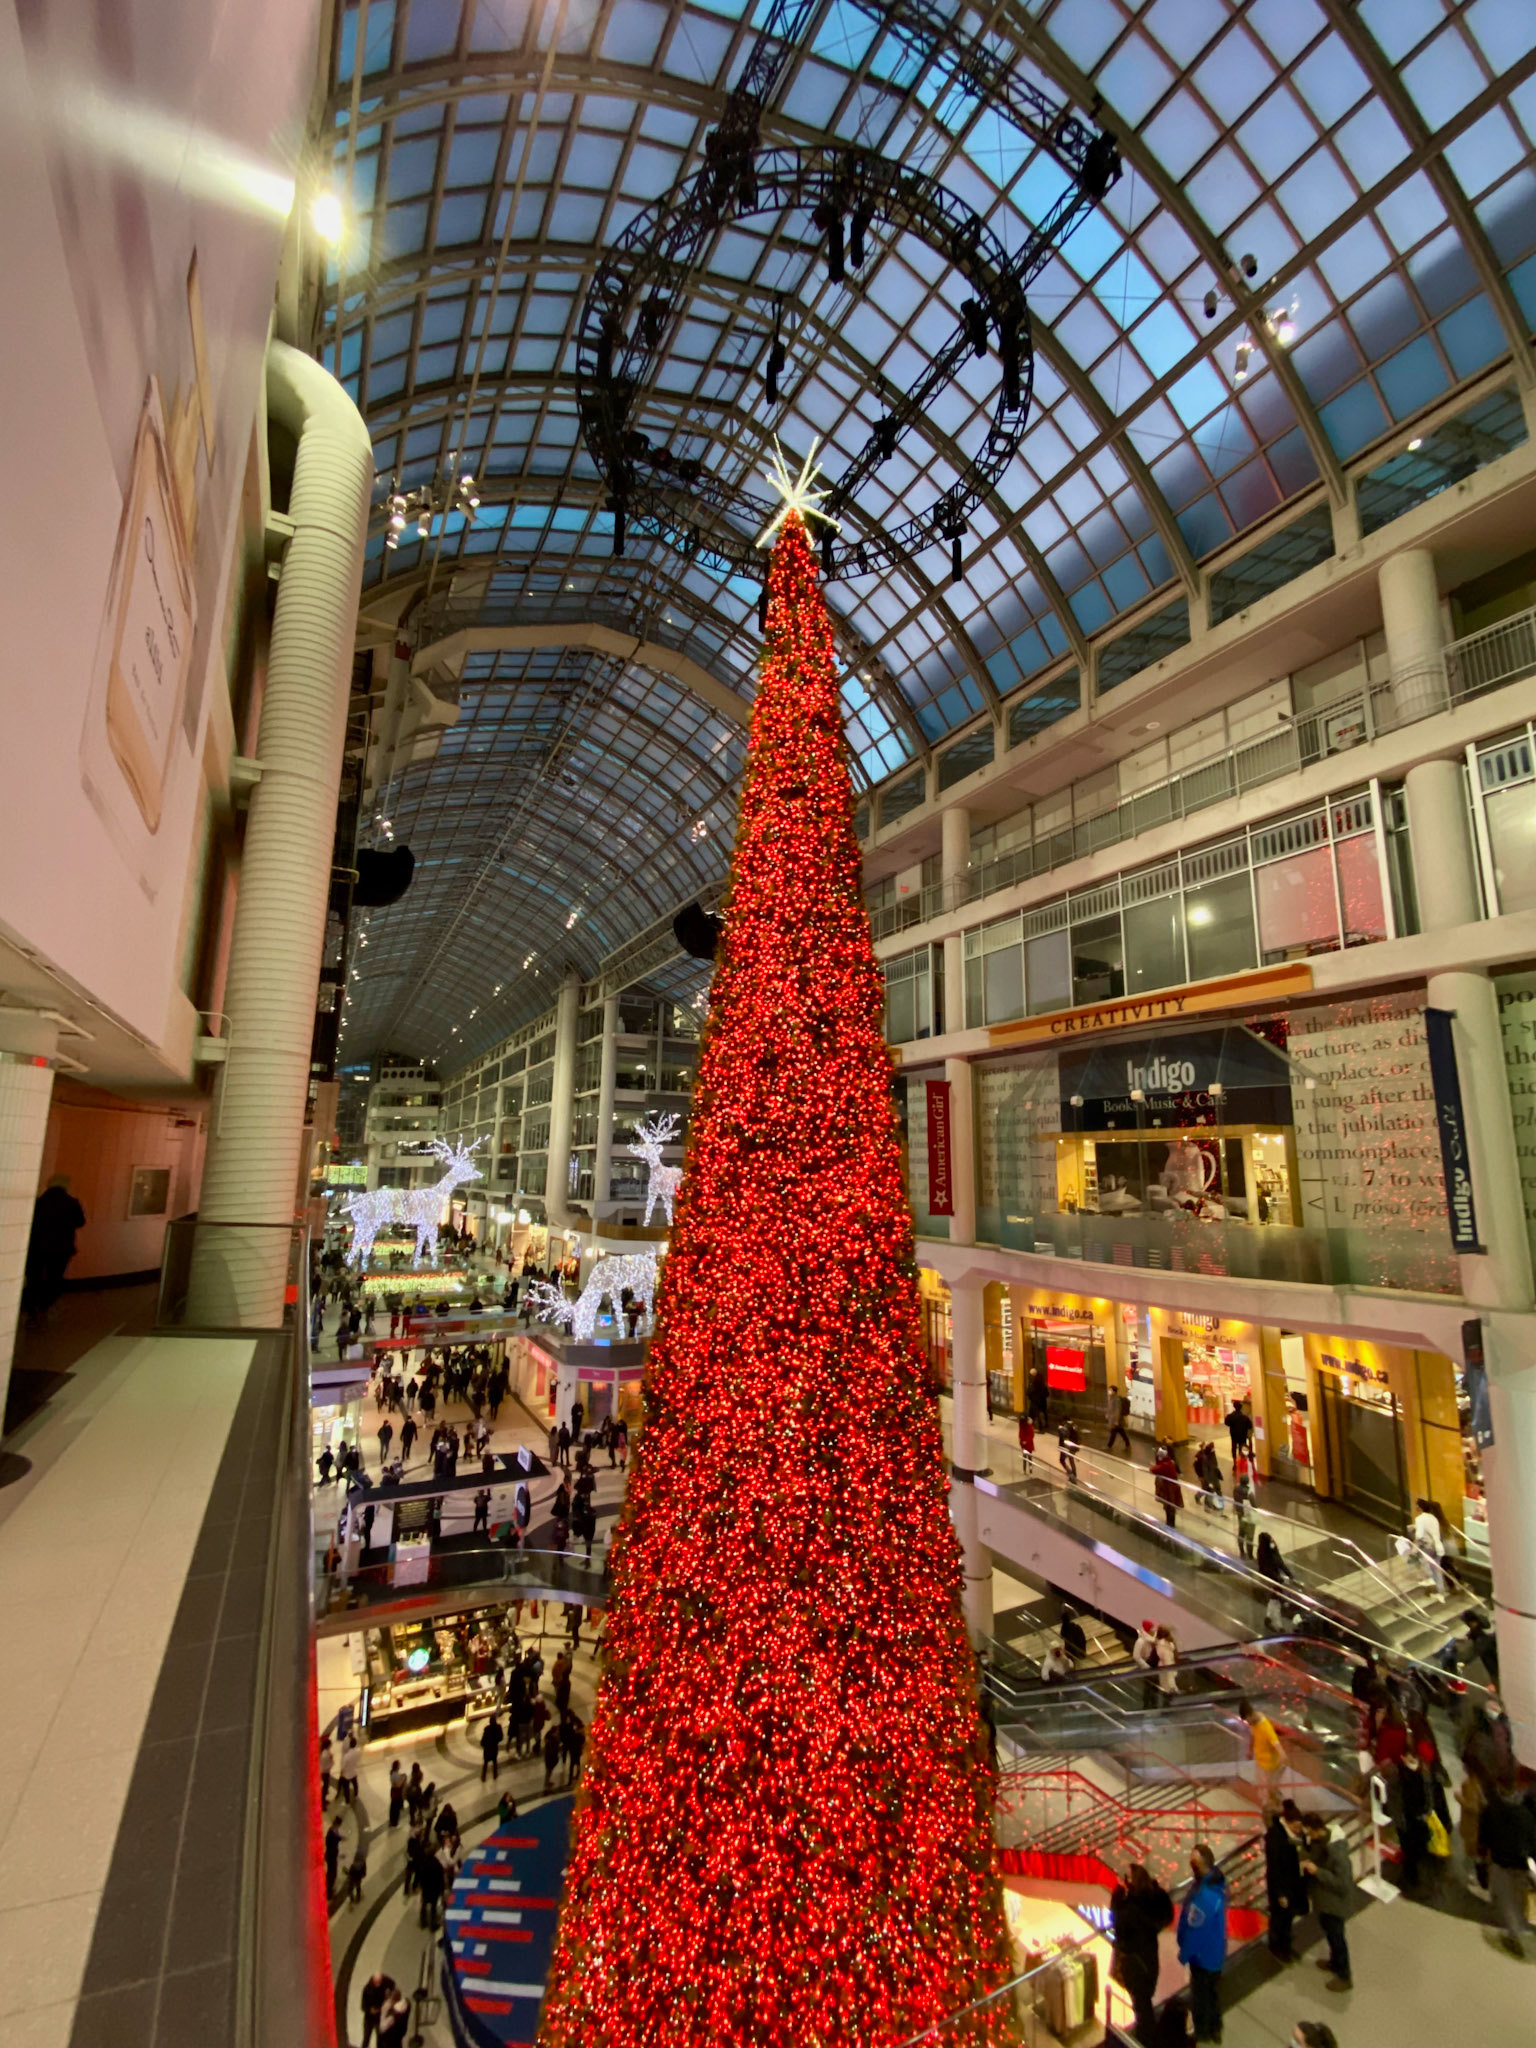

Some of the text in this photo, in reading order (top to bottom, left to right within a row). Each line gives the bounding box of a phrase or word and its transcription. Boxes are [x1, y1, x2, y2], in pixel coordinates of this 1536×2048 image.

[1051, 996, 1186, 1034] CREATIVITY
[1372, 1038, 1391, 1050] as
[1390, 1063, 1413, 1075] or
[1103, 1098, 1138, 1113] Books
[1143, 1096, 1178, 1110] Music
[1182, 1095, 1196, 1109] &
[1312, 1095, 1355, 1113] sung
[1360, 1086, 1406, 1105] after
[1309, 1121, 1336, 1135] the
[1342, 1114, 1424, 1138] jubilatio
[932, 1093, 946, 1187] American Girl
[1390, 1173, 1411, 1187] to
[1453, 1168, 1473, 1242] Indigo
